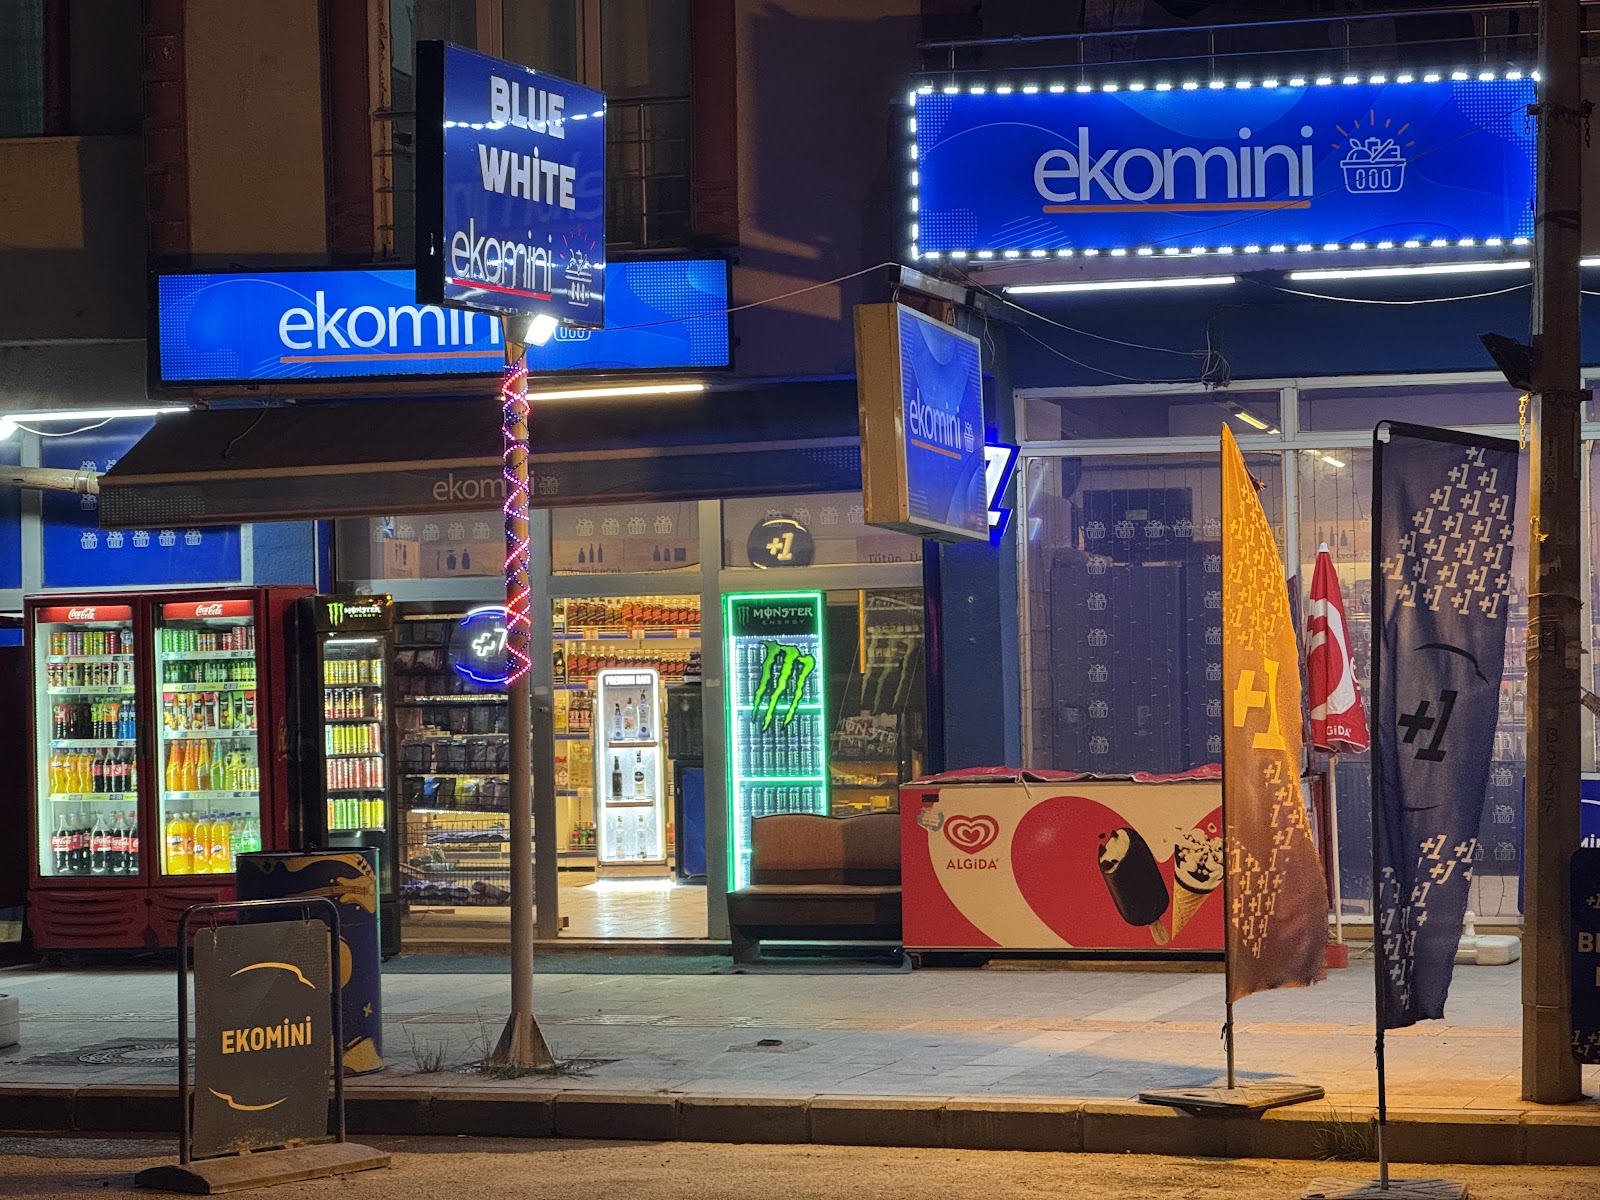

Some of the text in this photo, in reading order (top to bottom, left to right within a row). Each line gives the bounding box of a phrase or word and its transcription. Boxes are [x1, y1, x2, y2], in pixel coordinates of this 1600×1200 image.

[491, 75, 565, 139] BLUE
[1034, 125, 1314, 202] ekomini
[451, 217, 552, 292] ekomini
[279, 291, 500, 350] ekomin
[909, 388, 962, 450] ekomini
[432, 470, 535, 500] ekomi
[1448, 464, 1469, 489] +1
[1478, 468, 1498, 493] +1
[1430, 485, 1452, 511] +1
[1460, 490, 1481, 516] +1
[1489, 495, 1509, 520] +1
[1230, 518, 1244, 540] +1
[1412, 508, 1434, 534] +1
[1442, 512, 1464, 538] +1
[1472, 517, 1492, 542] +1
[766, 532, 794, 561] +1
[1399, 531, 1417, 557] +1
[1424, 535, 1447, 561] +1
[1454, 539, 1476, 565] +1
[1483, 544, 1503, 569] +1
[1253, 548, 1265, 570] +1
[1381, 554, 1404, 580] +1
[1412, 558, 1429, 584] +1
[1262, 572, 1275, 593] +1
[1437, 562, 1460, 588] +1
[1467, 566, 1488, 592] +1
[1238, 585, 1252, 607] +1
[1272, 596, 1284, 617] +1
[1396, 581, 1417, 607] +1
[1423, 585, 1443, 611] +1
[1451, 589, 1472, 615] +1
[1479, 593, 1500, 618] +1
[753, 606, 813, 620] MONSTER
[1263, 614, 1276, 636] +1
[1237, 628, 1254, 651] +1
[1234, 657, 1286, 751] +1
[1397, 689, 1458, 762] +1
[1263, 761, 1281, 784] +1
[1275, 784, 1293, 806] +1
[1273, 827, 1294, 849] +1
[1420, 834, 1447, 860] +1
[1454, 838, 1477, 863] +1
